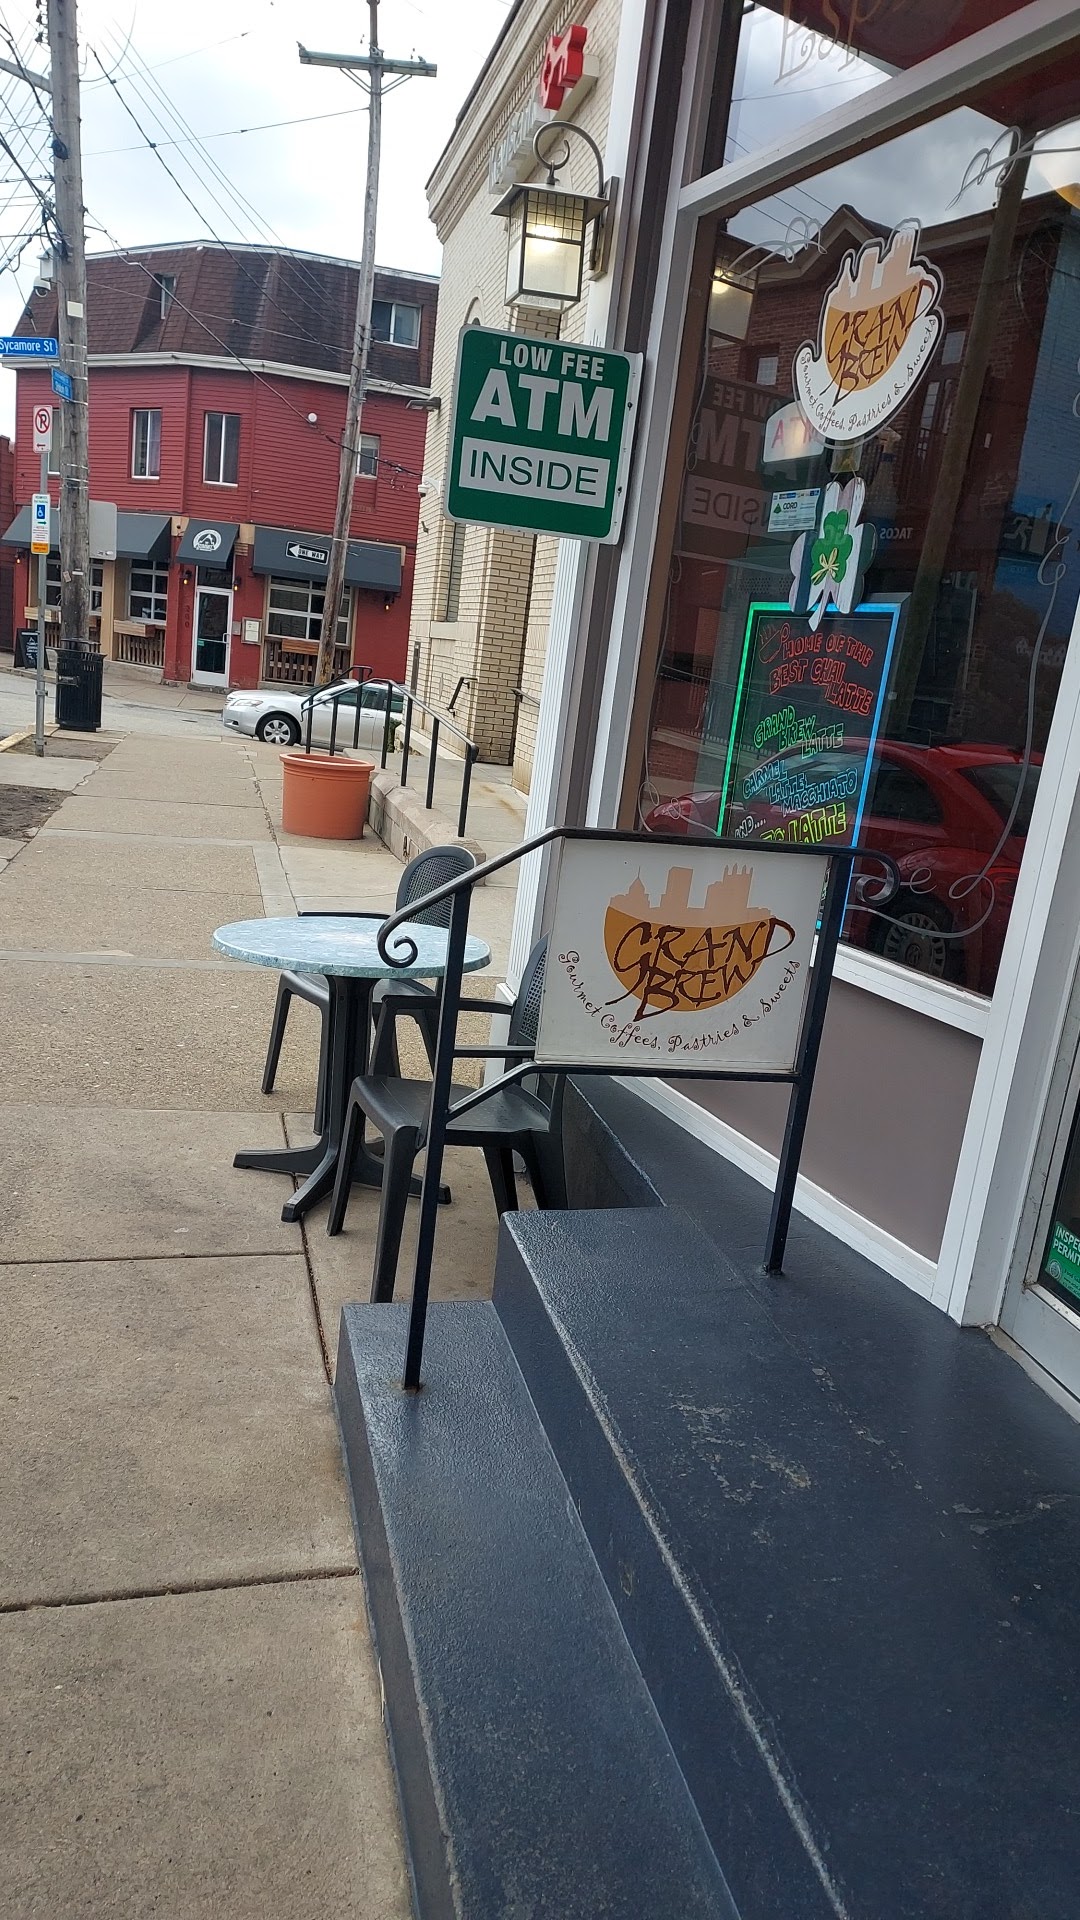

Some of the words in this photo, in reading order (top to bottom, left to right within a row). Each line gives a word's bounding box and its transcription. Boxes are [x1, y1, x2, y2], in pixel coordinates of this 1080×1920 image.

[0, 339, 41, 353] Sycamore
[43, 340, 53, 352] St
[819, 279, 935, 396] GRAND
[499, 341, 553, 372] LOW
[560, 351, 605, 382] FEE
[801, 351, 819, 409] Gourmet
[848, 394, 892, 432] Pastries
[894, 381, 906, 396] &
[907, 318, 936, 383] Sweets
[832, 330, 908, 407] BREW
[470, 368, 615, 442] ATM
[470, 449, 599, 496] INSIDE
[311, 551, 324, 560] WAY
[783, 633, 823, 660] HOME
[825, 633, 846, 653] OF
[846, 636, 874, 668] THE
[769, 659, 809, 695] BEST
[811, 658, 846, 684] CHAI
[825, 681, 874, 717] LATTE
[754, 705, 796, 749] GRAND
[778, 715, 816, 752] BREW
[801, 723, 844, 759] LATTE
[743, 760, 788, 799] CARMEL
[768, 773, 806, 805] LATTE
[788, 801, 847, 843] LATTE
[605, 917, 795, 1006] GRAND
[558, 950, 602, 1018] Gourmet
[600, 1013, 661, 1050] Coffees,
[667, 1022, 740, 1053] Pastries
[742, 1013, 760, 1029] &
[759, 959, 801, 1018] Sweets
[633, 960, 758, 1022] BREW
